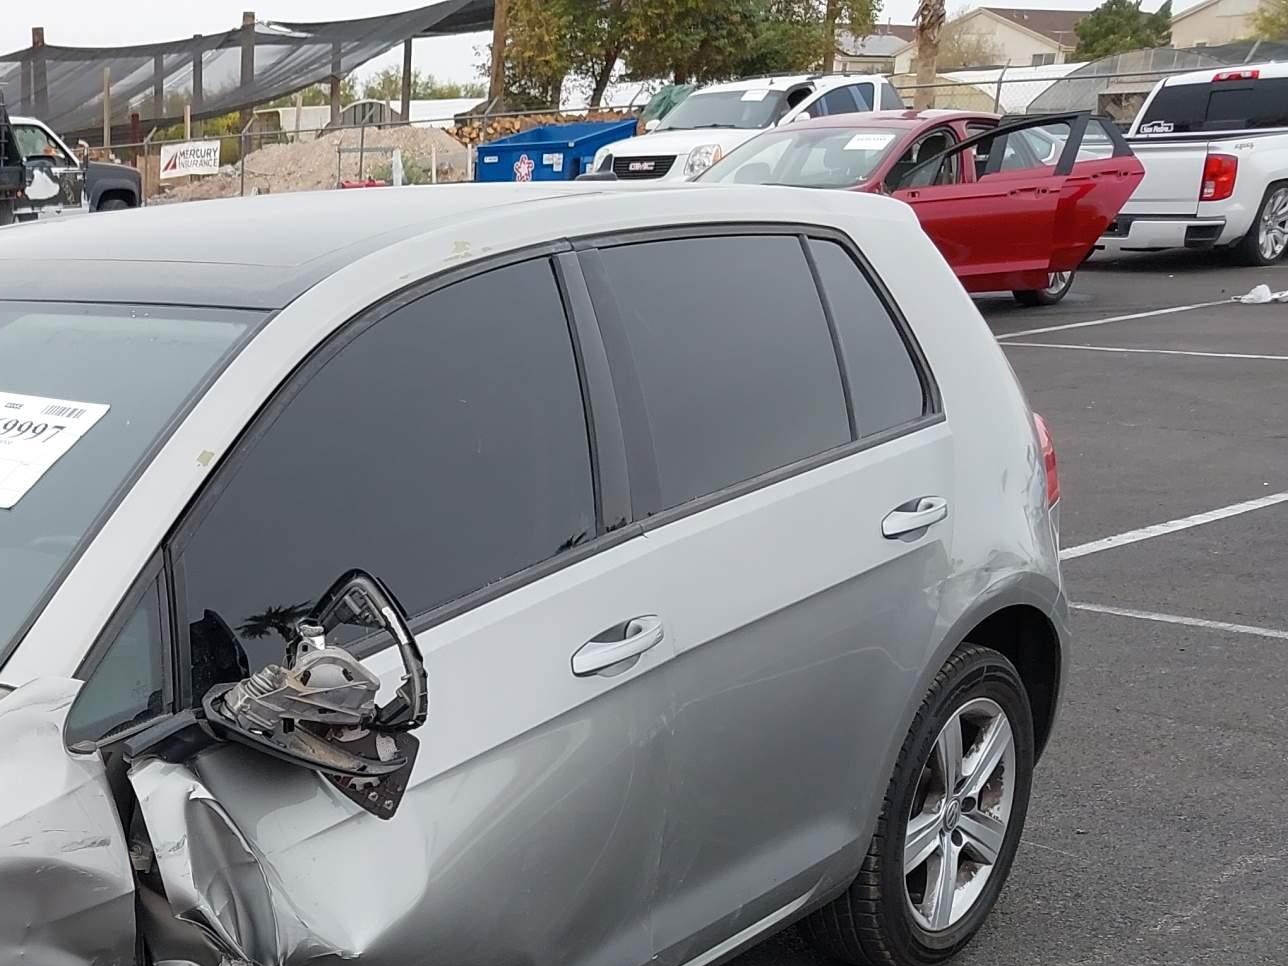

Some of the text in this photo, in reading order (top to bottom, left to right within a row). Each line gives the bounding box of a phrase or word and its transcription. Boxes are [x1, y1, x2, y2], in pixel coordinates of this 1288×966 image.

[179, 147, 218, 159] MERCURY
[179, 157, 218, 168] INSURANCE
[629, 161, 655, 171] GMC
